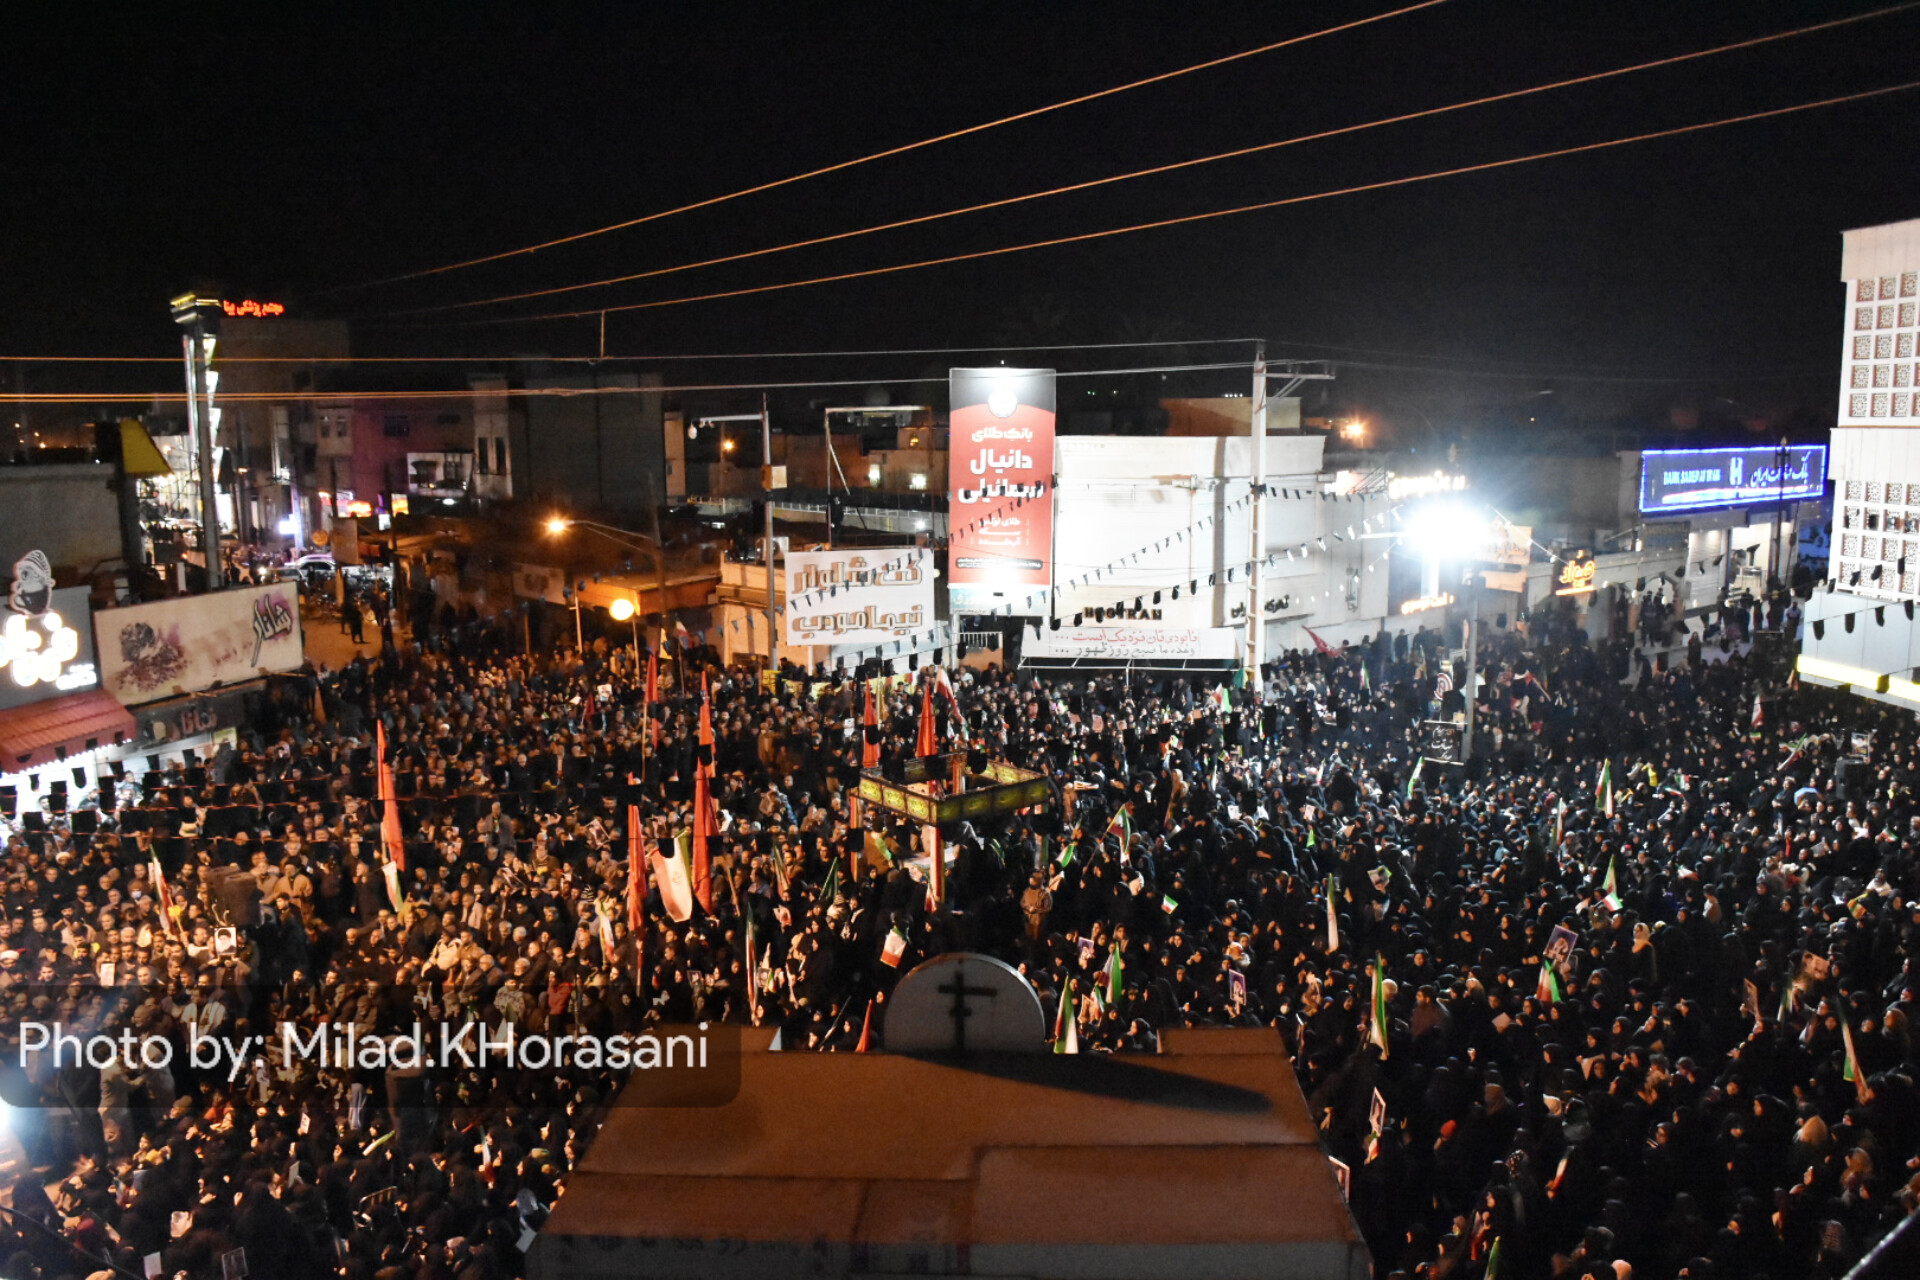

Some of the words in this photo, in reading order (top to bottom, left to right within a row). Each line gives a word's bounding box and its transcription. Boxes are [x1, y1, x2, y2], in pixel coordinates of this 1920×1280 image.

[971, 426, 1003, 442] طلای
[970, 448, 1033, 475] دانیال
[792, 556, 873, 593] شلوار
[876, 559, 923, 587] کت
[865, 604, 923, 636] نیما
[1072, 628, 1107, 643] است
